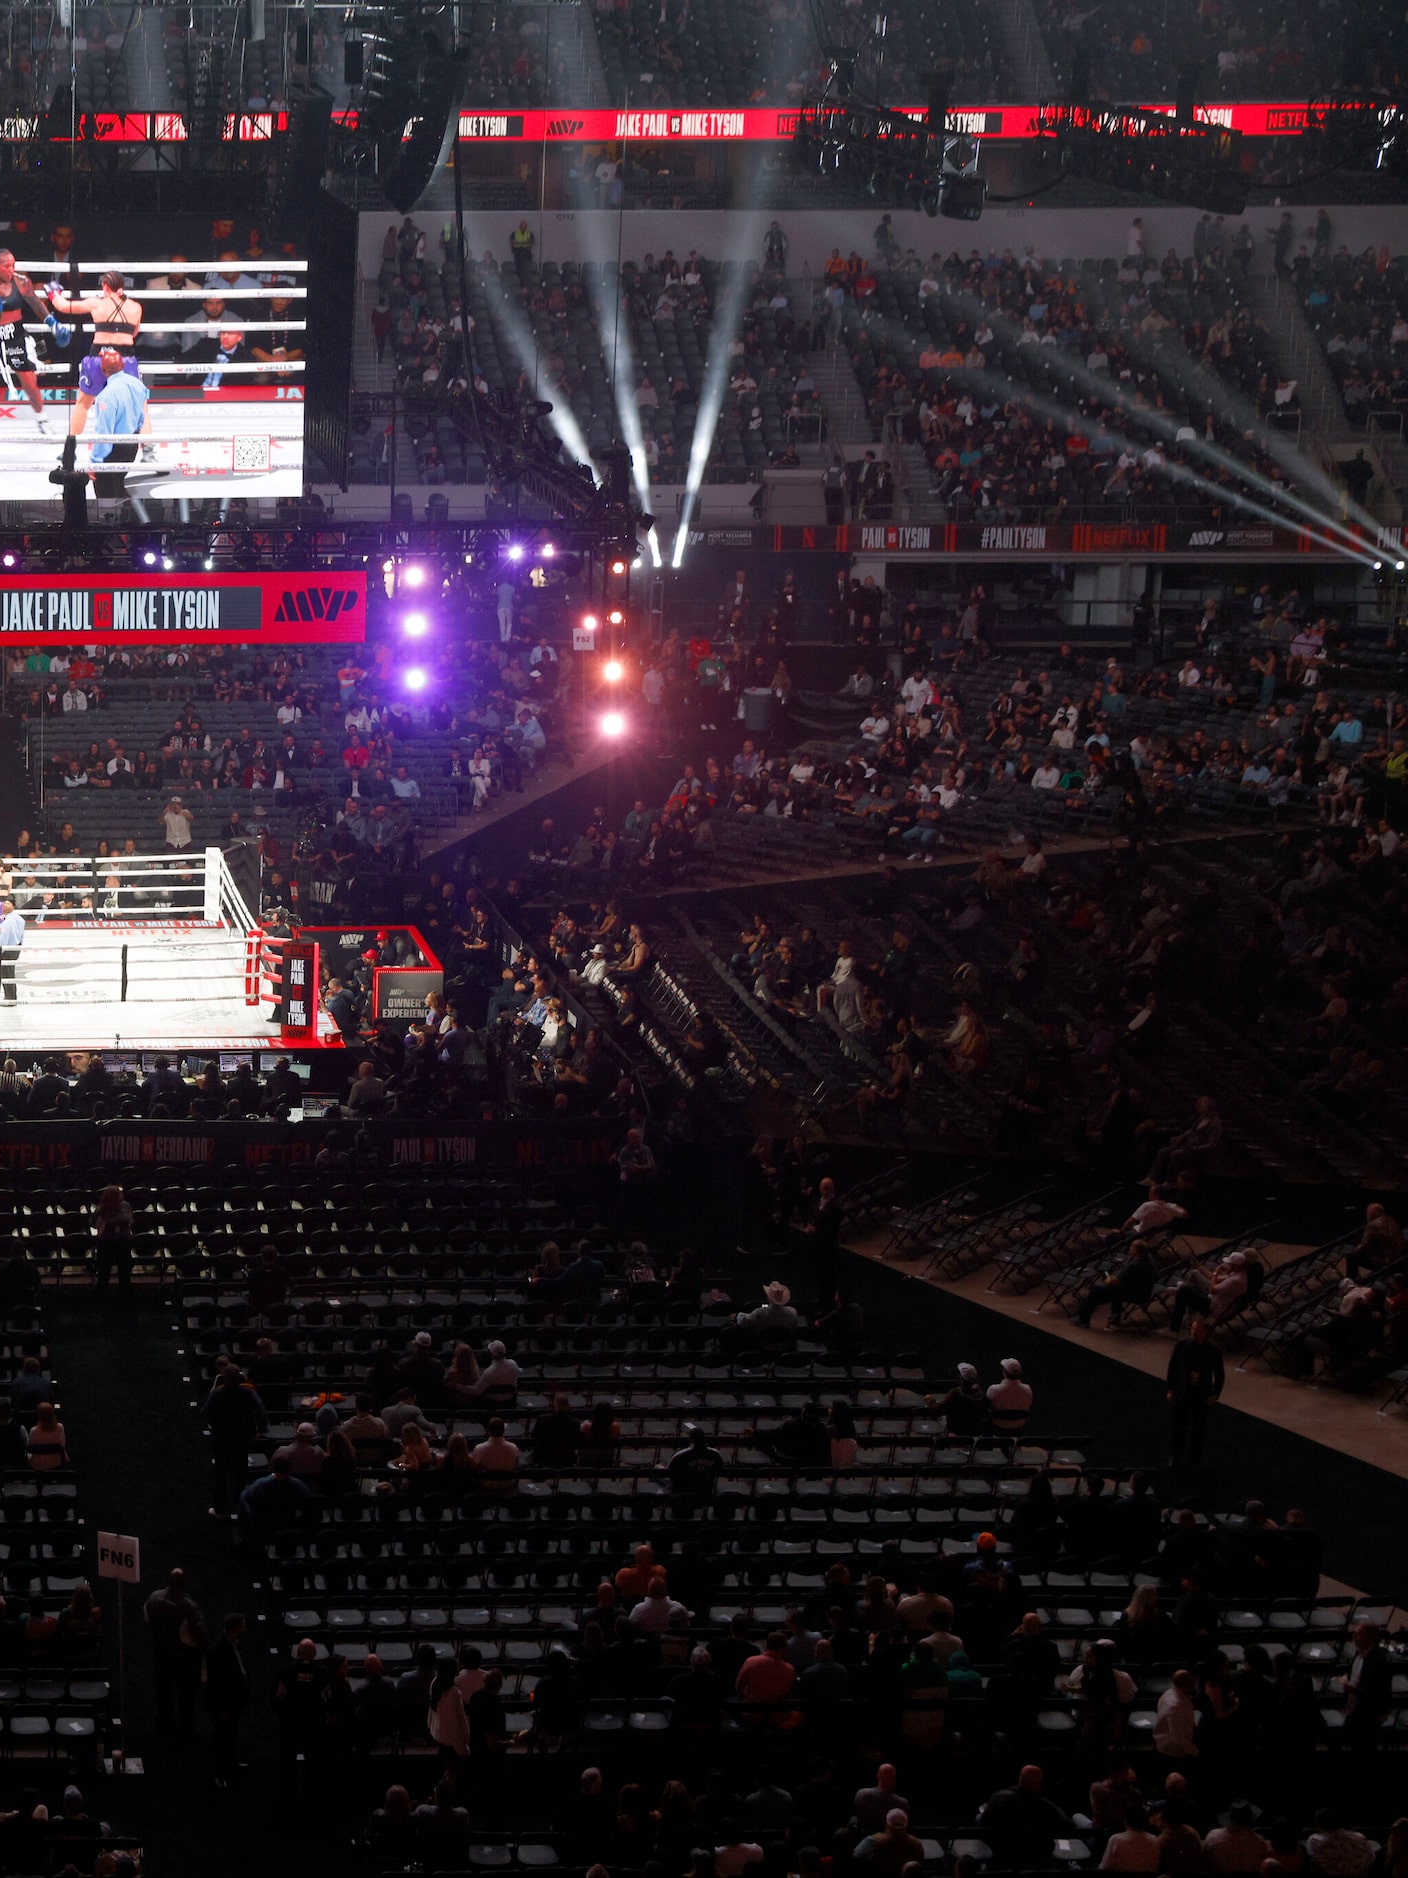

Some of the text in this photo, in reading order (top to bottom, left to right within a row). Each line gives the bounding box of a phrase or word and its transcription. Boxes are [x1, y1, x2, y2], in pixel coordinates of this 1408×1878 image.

[479, 116, 507, 137] TYSON
[615, 112, 744, 137] JAKE PAUL VS MIKE TYSON
[956, 112, 986, 134] TYSON
[862, 527, 886, 549] PAUL
[898, 527, 930, 549] TYSON
[980, 527, 1046, 549] #PAULTYSON
[1377, 526, 1403, 550] PAUL
[1, 592, 43, 631] JAKE
[48, 591, 91, 630] PAUL
[97, 600, 109, 621] VS
[113, 591, 157, 630] MIKE
[162, 590, 220, 629] TYSON
[274, 588, 358, 622] MVP
[72, 920, 102, 929] JAKE
[104, 920, 132, 929] PAUL
[147, 920, 175, 928] MIKE
[177, 919, 220, 928] TYSON
[111, 929, 192, 937] NETFLIX
[290, 959, 305, 973] JAKE
[290, 971, 305, 986] PAUL
[289, 1000, 304, 1014] MIKE
[287, 1012, 307, 1026] TYSON
[100, 1136, 140, 1162] TAYLOR
[393, 1137, 476, 1163] PAUL TYSON
[100, 1548, 135, 1569] FN6
